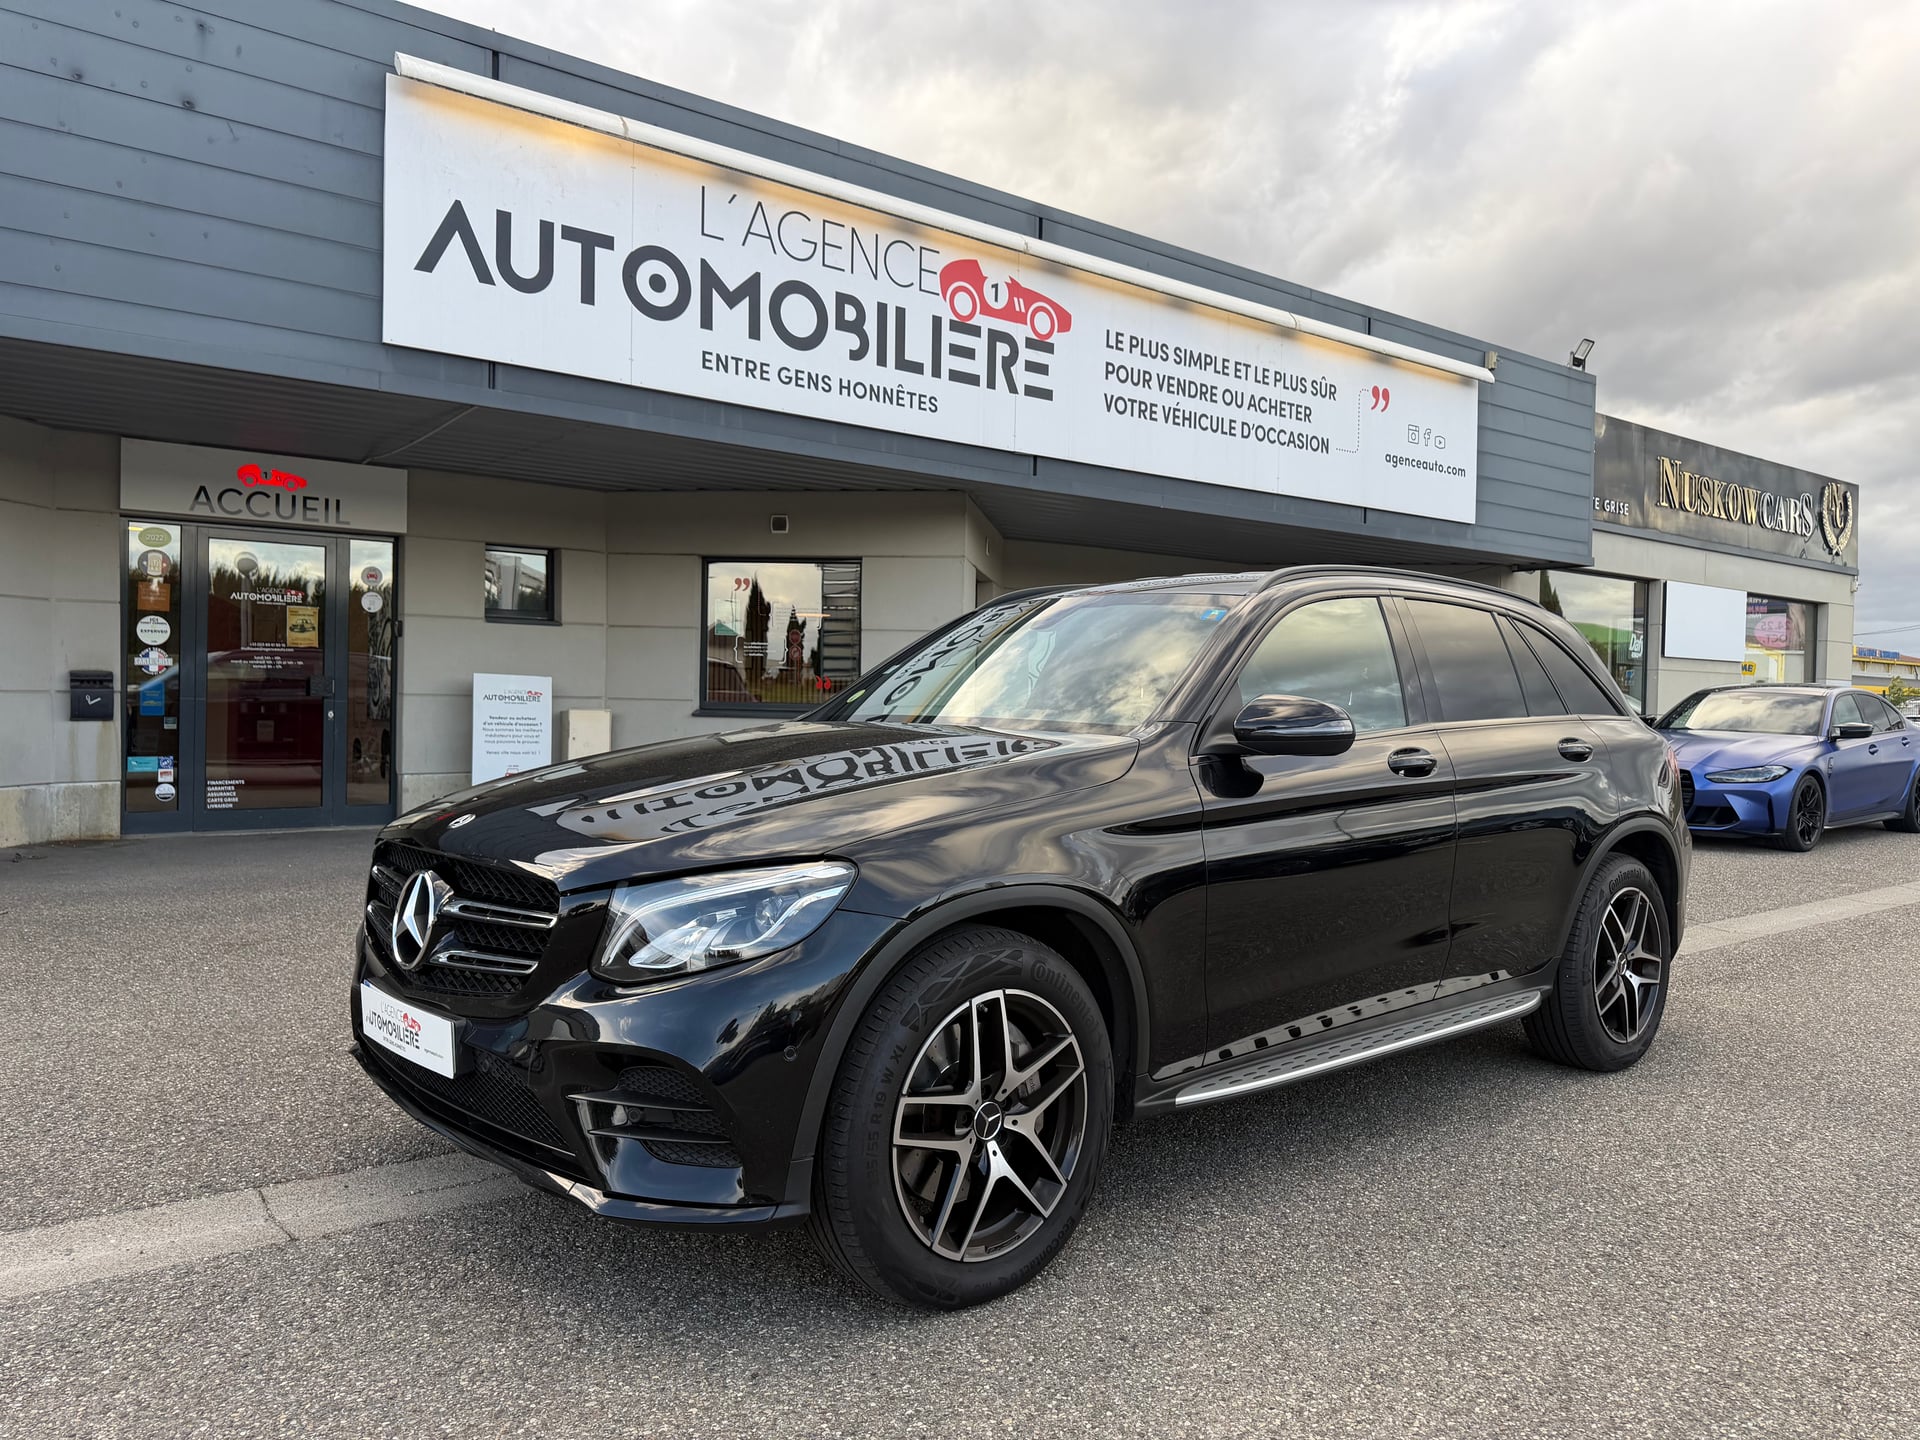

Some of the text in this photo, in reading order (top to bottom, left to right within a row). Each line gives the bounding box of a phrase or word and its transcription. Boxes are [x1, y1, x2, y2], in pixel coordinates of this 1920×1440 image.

[700, 184, 942, 297] L'AGENCE
[702, 350, 939, 413] ENTRE GENS HONNÊTES
[1105, 329, 1337, 401] LE PLUS SIMPLE ET LE PLUS SÛR
[1105, 362, 1312, 424] POUR VENDRE OU ACHETER
[1104, 393, 1330, 454] VOTRE VÉHICULE D'OCCASION
[1385, 451, 1466, 478] agenceauto.com
[189, 485, 350, 525] ACCUEIL
[1604, 499, 1629, 516] GRISE
[1031, 959, 1099, 1033] Continental
